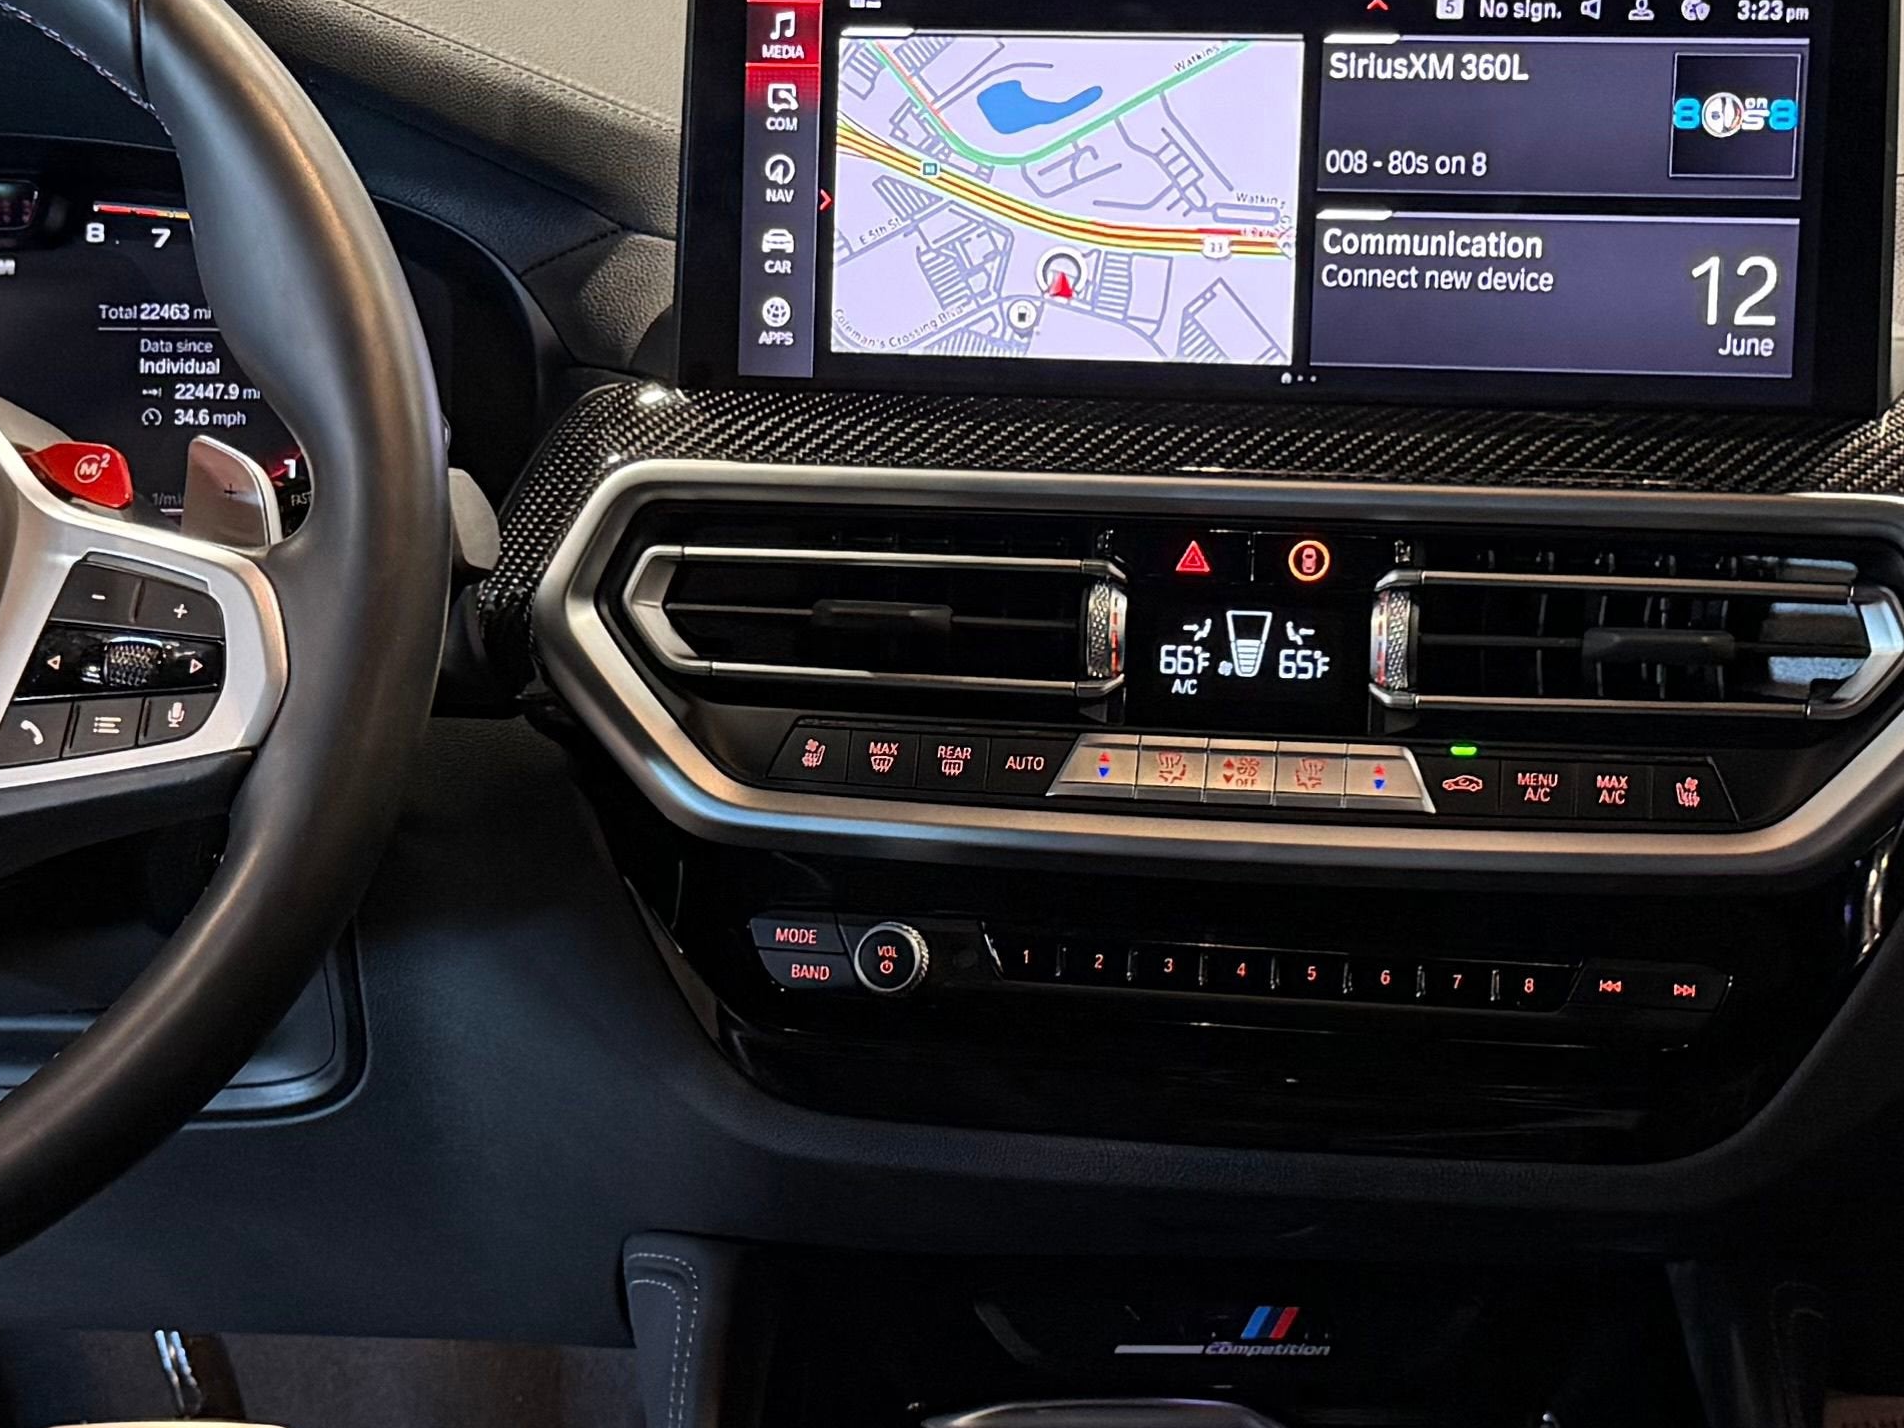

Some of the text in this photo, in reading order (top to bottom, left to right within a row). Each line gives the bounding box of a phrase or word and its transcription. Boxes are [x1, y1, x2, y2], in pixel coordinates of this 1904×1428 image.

[1480, 0, 1508, 18] No
[1513, 0, 1561, 21] sign.
[1738, 0, 1783, 20] 3:23
[1787, 5, 1809, 23] pm
[762, 45, 804, 59] MEDIA
[1329, 53, 1529, 81] SiriusXM 360L
[766, 117, 798, 131] COM
[1326, 149, 1367, 174] 008
[1388, 151, 1429, 174] 80s
[1435, 156, 1466, 175] on
[1472, 152, 1487, 176] 8
[766, 188, 794, 203] NAV
[85, 222, 171, 249] 8 7
[1323, 228, 1542, 259] Communication
[764, 260, 792, 274] CAR
[1322, 264, 1554, 292] Connect new device
[1691, 255, 1779, 327] 12
[99, 304, 212, 320] Total 22463 mi
[759, 331, 794, 345] APPS
[1718, 333, 1775, 357] June
[140, 339, 213, 353] Data since
[140, 358, 220, 374] Individual
[174, 383, 239, 400] 22447.9
[174, 409, 246, 427] 34.6 mph
[1171, 679, 1198, 695] A/C
[869, 742, 899, 756] MAX
[937, 746, 972, 759] REAR
[1005, 756, 1045, 771] AUTO
[1236, 778, 1257, 788] OFF
[1517, 773, 1558, 787] MENU
[1596, 775, 1628, 789] MAX
[1524, 787, 1551, 802] A/C
[1599, 789, 1625, 804] A/C
[775, 928, 817, 944] MODE
[877, 946, 898, 958] VOL
[1023, 950, 1029, 963] 1
[1094, 954, 1104, 969] 2
[1164, 958, 1173, 972] 3
[791, 964, 830, 981] BAND
[1236, 963, 1246, 977] 4
[1307, 966, 1316, 980] 5
[1380, 970, 1390, 985] 6
[1452, 974, 1462, 989] 7
[1524, 978, 1534, 993] 8
